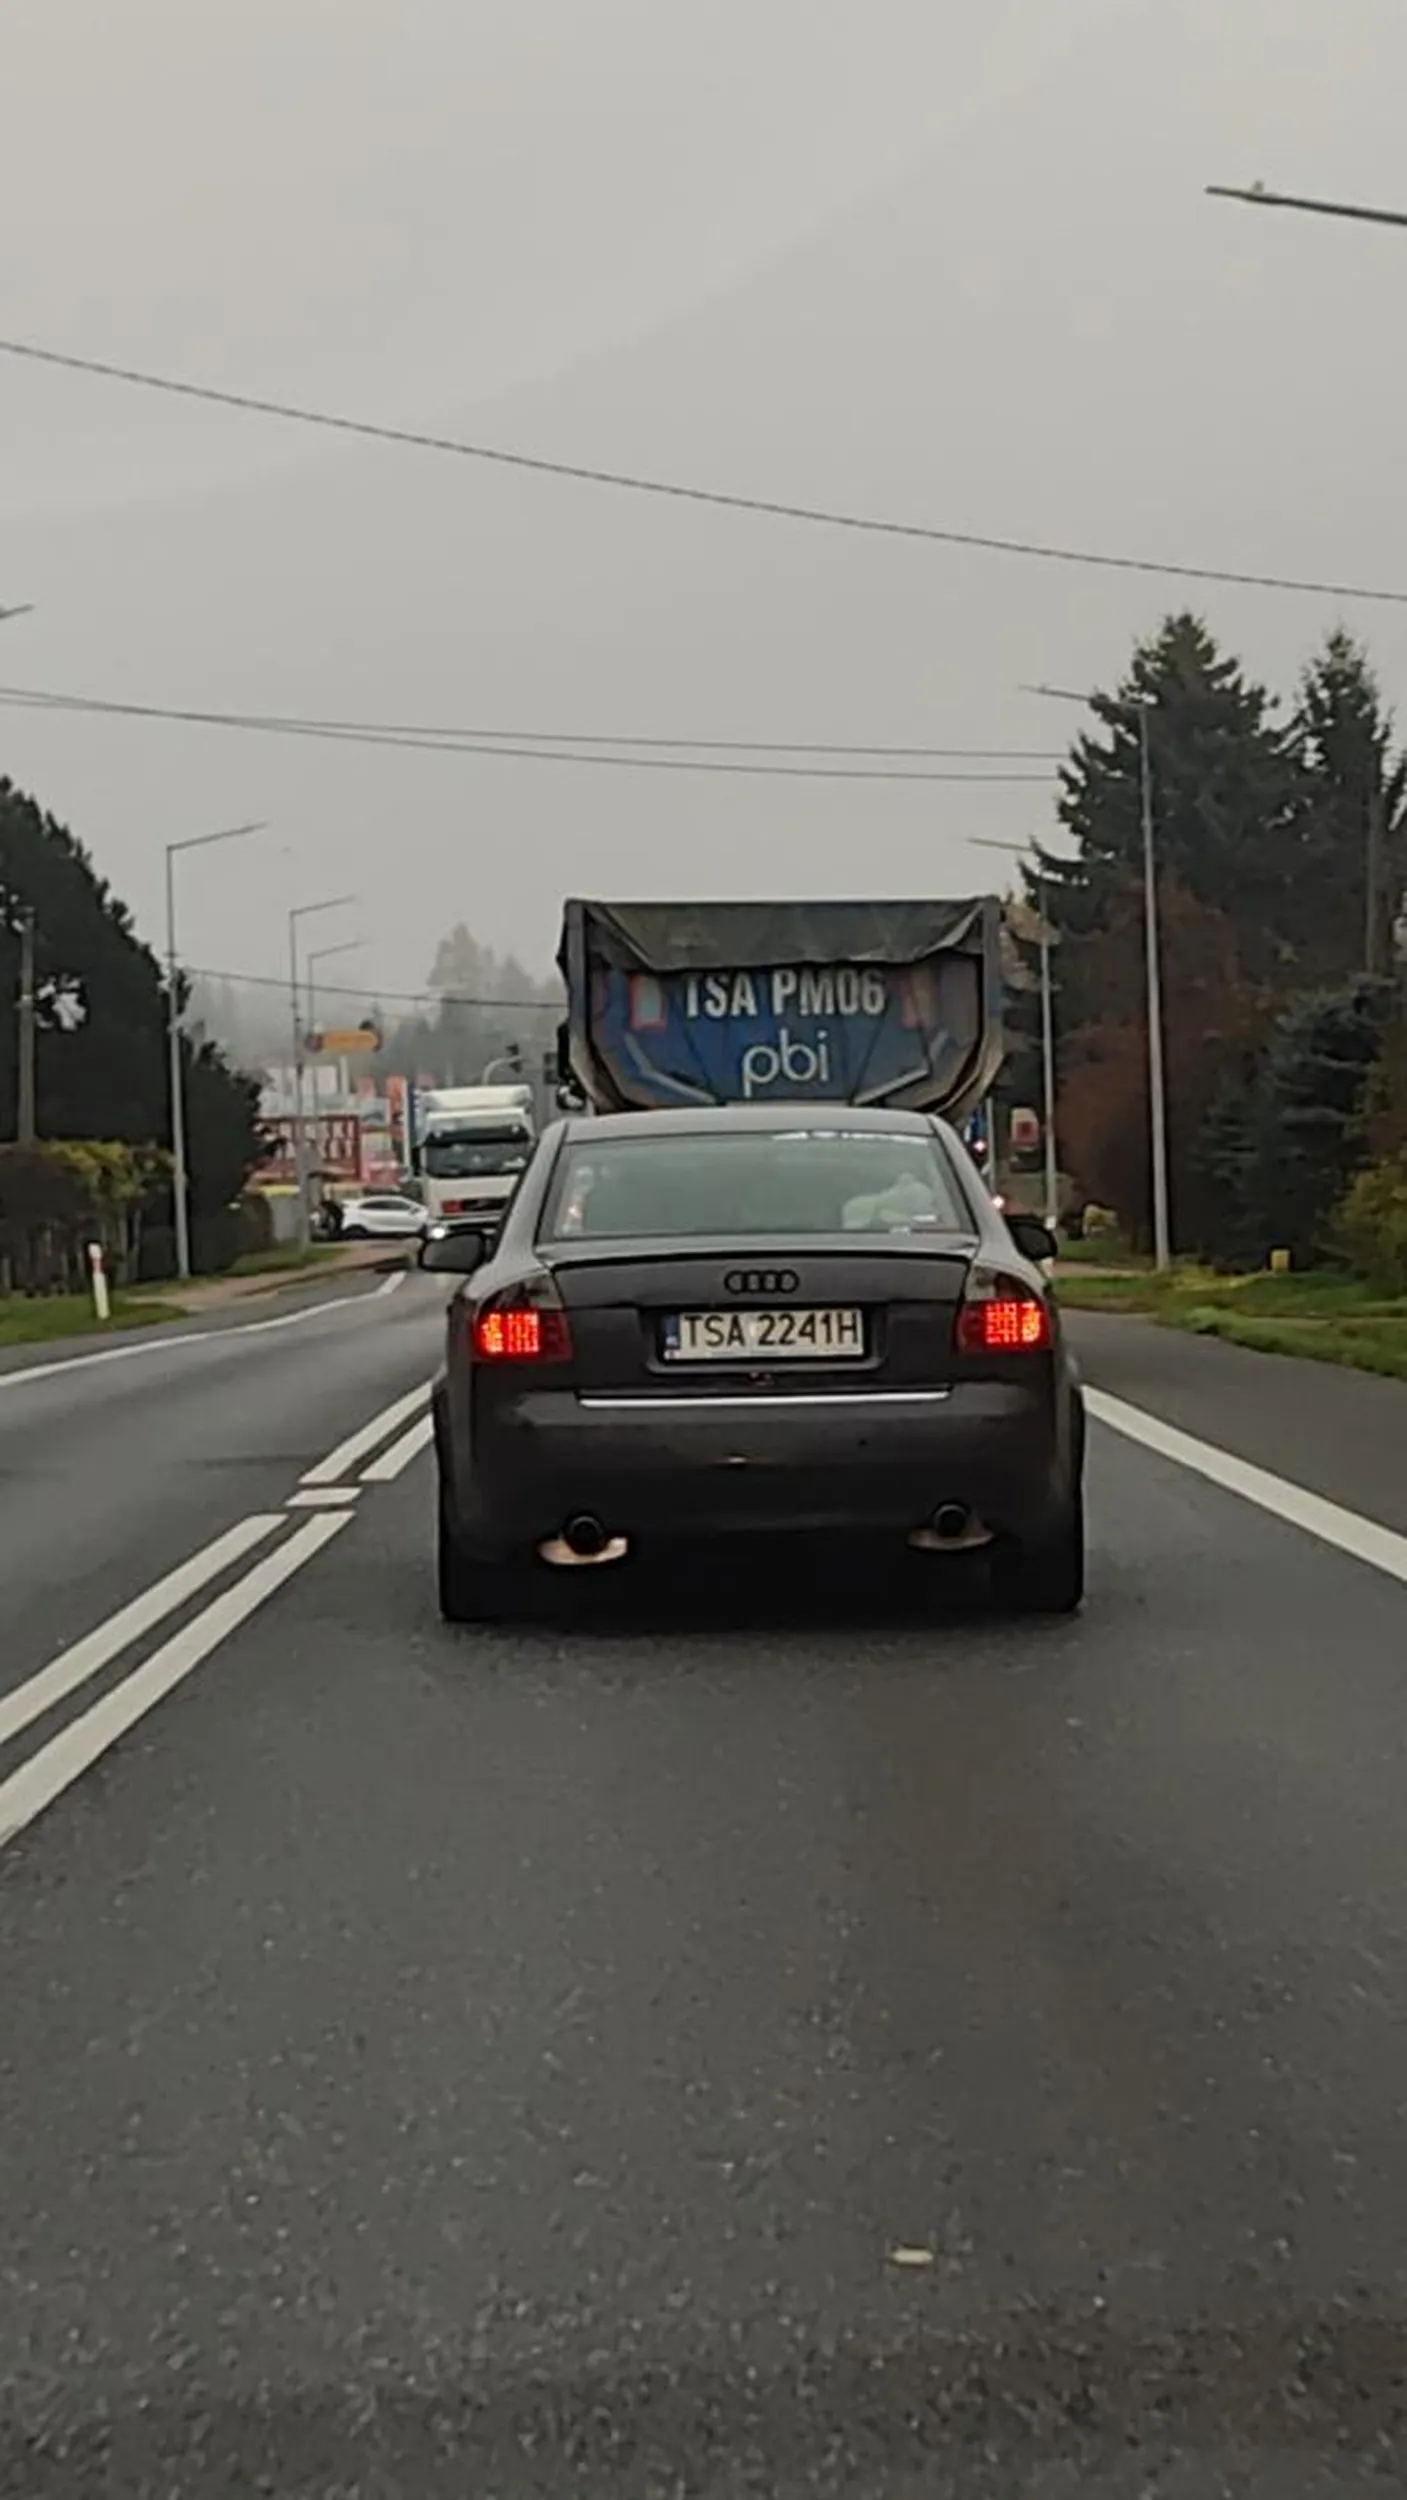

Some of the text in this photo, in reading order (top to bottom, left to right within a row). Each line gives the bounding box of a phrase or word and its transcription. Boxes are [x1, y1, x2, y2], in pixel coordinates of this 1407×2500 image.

[772, 969, 886, 1016] PM06
[743, 1027, 829, 1098] pbi
[684, 1312, 858, 1347] TSA 2241H
